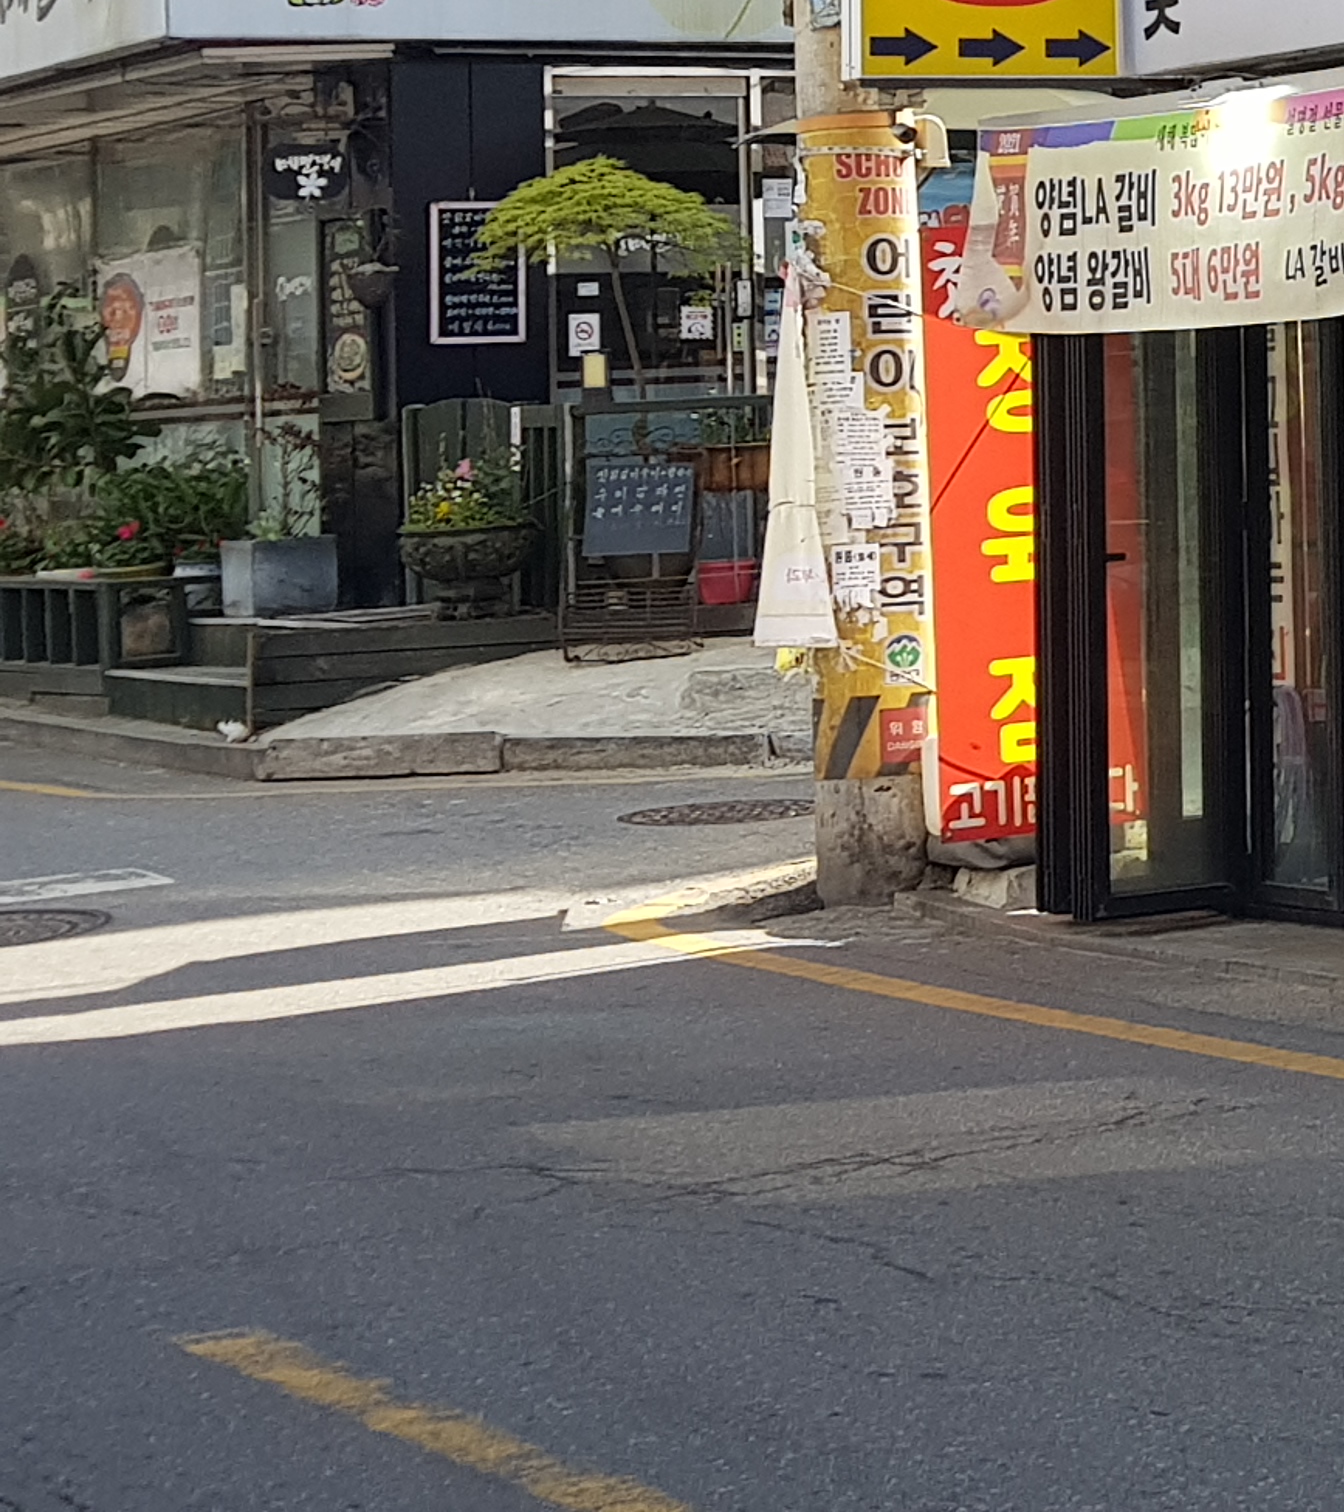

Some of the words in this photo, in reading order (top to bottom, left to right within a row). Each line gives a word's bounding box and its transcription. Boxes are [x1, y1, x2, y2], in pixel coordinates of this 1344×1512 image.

[1115, 169, 1158, 234] 갈비
[1171, 169, 1211, 227] 3kg
[1034, 249, 1077, 313] 양념
[1086, 245, 1152, 312] 왕갈비
[1169, 245, 1202, 304] 5대
[1207, 241, 1262, 301] 6만원
[1285, 246, 1306, 281] LA
